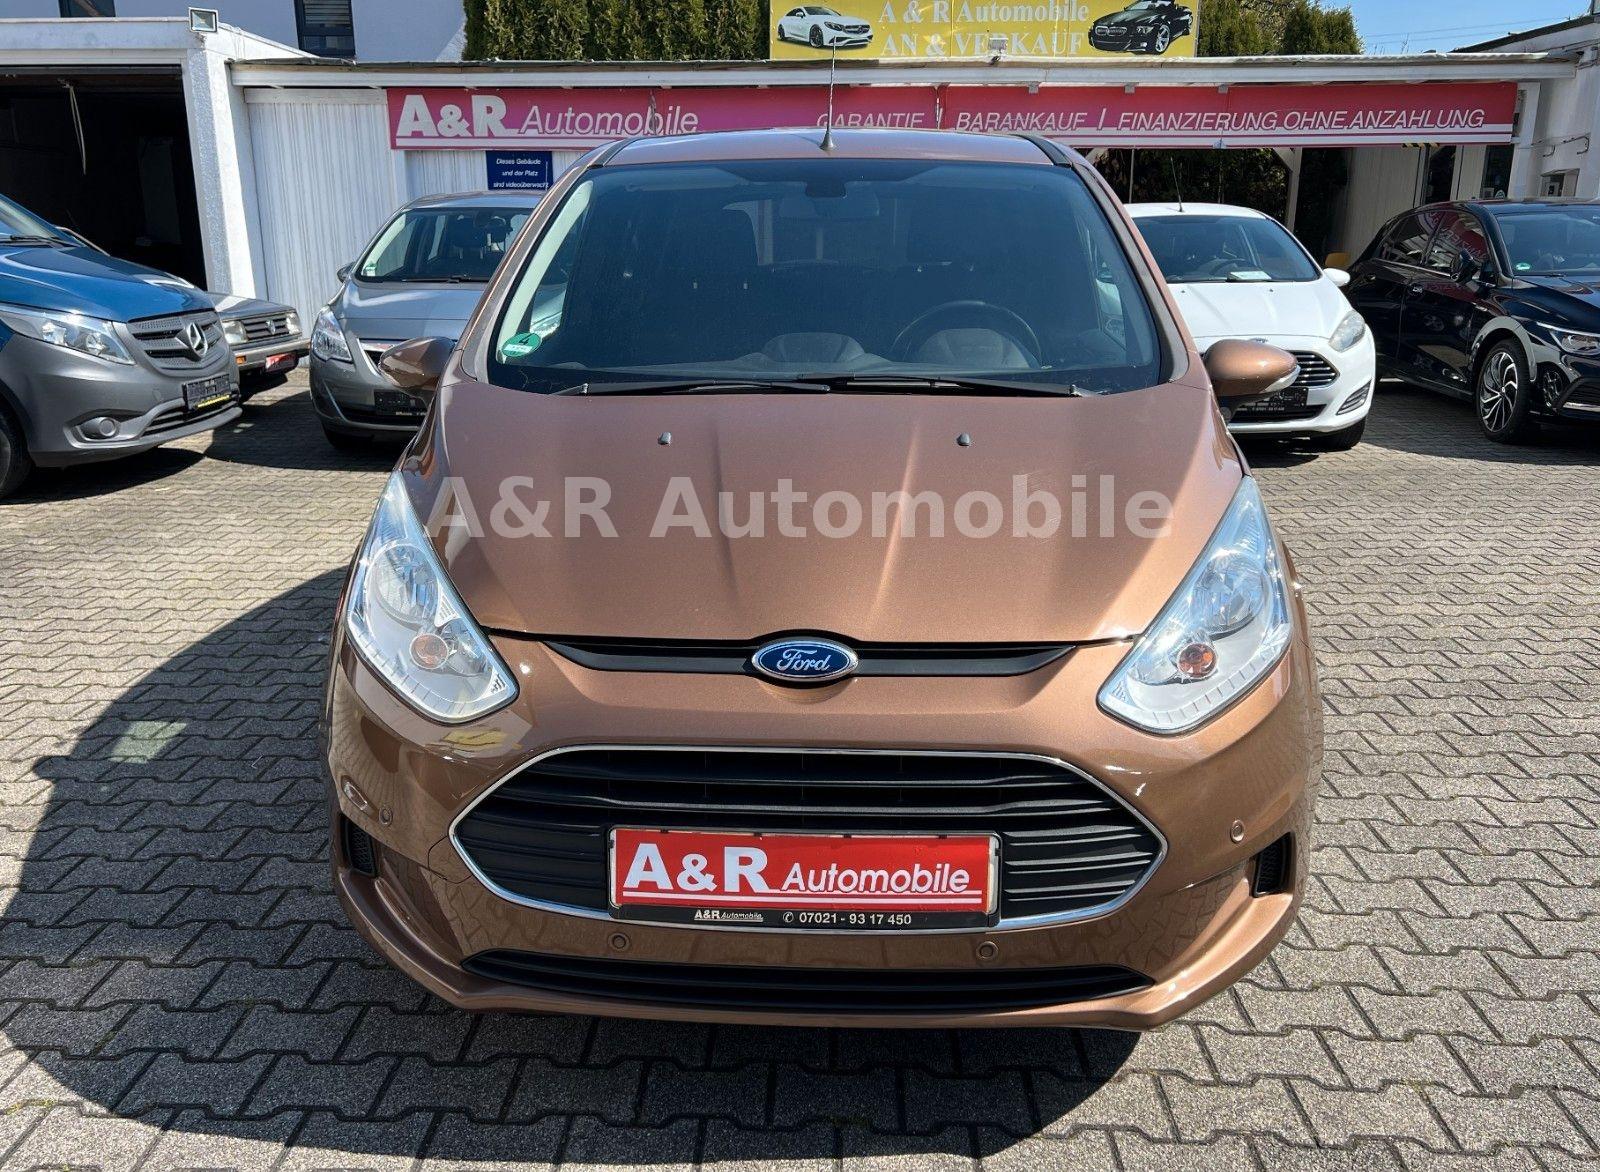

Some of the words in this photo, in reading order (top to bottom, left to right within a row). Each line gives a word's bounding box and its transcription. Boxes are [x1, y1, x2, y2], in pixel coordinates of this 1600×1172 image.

[878, 0, 897, 23] A
[903, 0, 923, 23] &
[932, 0, 950, 23] R
[956, 0, 1090, 22] Automobile
[880, 33, 918, 56] AN
[926, 33, 946, 57] &
[396, 94, 507, 137] A&R
[519, 105, 699, 135] Automobile
[955, 112, 1088, 132] BARANKAUF
[1117, 110, 1278, 131] FINANZIERUNG
[1283, 110, 1348, 130] OHNE
[1354, 109, 1486, 129] ANZAHLUNG
[776, 648, 832, 671] Ford
[622, 842, 768, 892] A&R
[781, 862, 970, 893] Automobile
[694, 909, 720, 919] A&R
[721, 911, 762, 920] Automobile
[799, 912, 837, 924] 07021
[849, 913, 866, 924] 93
[869, 913, 883, 925] 17
[887, 914, 912, 925] 450
